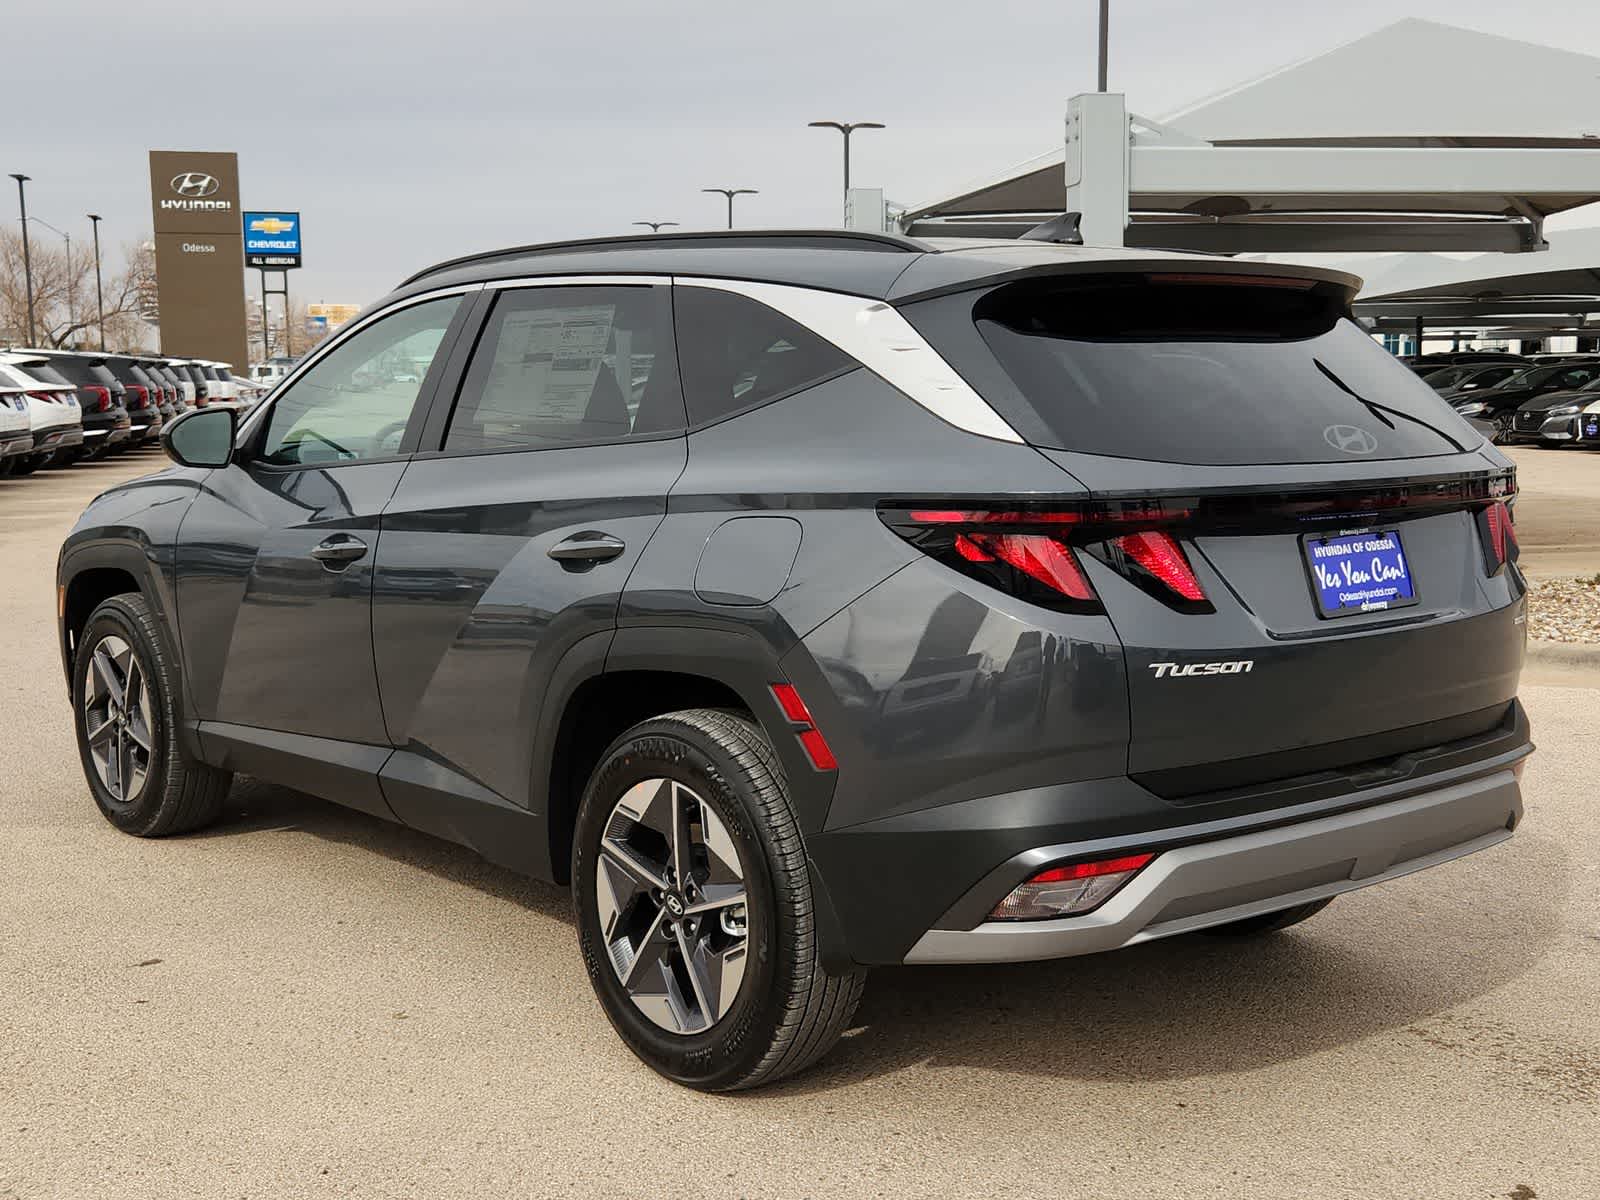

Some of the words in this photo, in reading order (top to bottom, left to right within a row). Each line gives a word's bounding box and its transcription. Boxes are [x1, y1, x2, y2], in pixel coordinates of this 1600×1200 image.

[182, 242, 215, 253] Odessa
[248, 240, 297, 249] CHEVROLET
[251, 257, 263, 265] ALL
[265, 257, 296, 265] AMERICAN
[1313, 545, 1353, 558] HYUNDAI
[1353, 543, 1364, 553] OF
[1364, 539, 1395, 552] ODESSA
[1314, 563, 1342, 590] Yes
[1340, 560, 1371, 587] You
[1371, 553, 1406, 582] Can!
